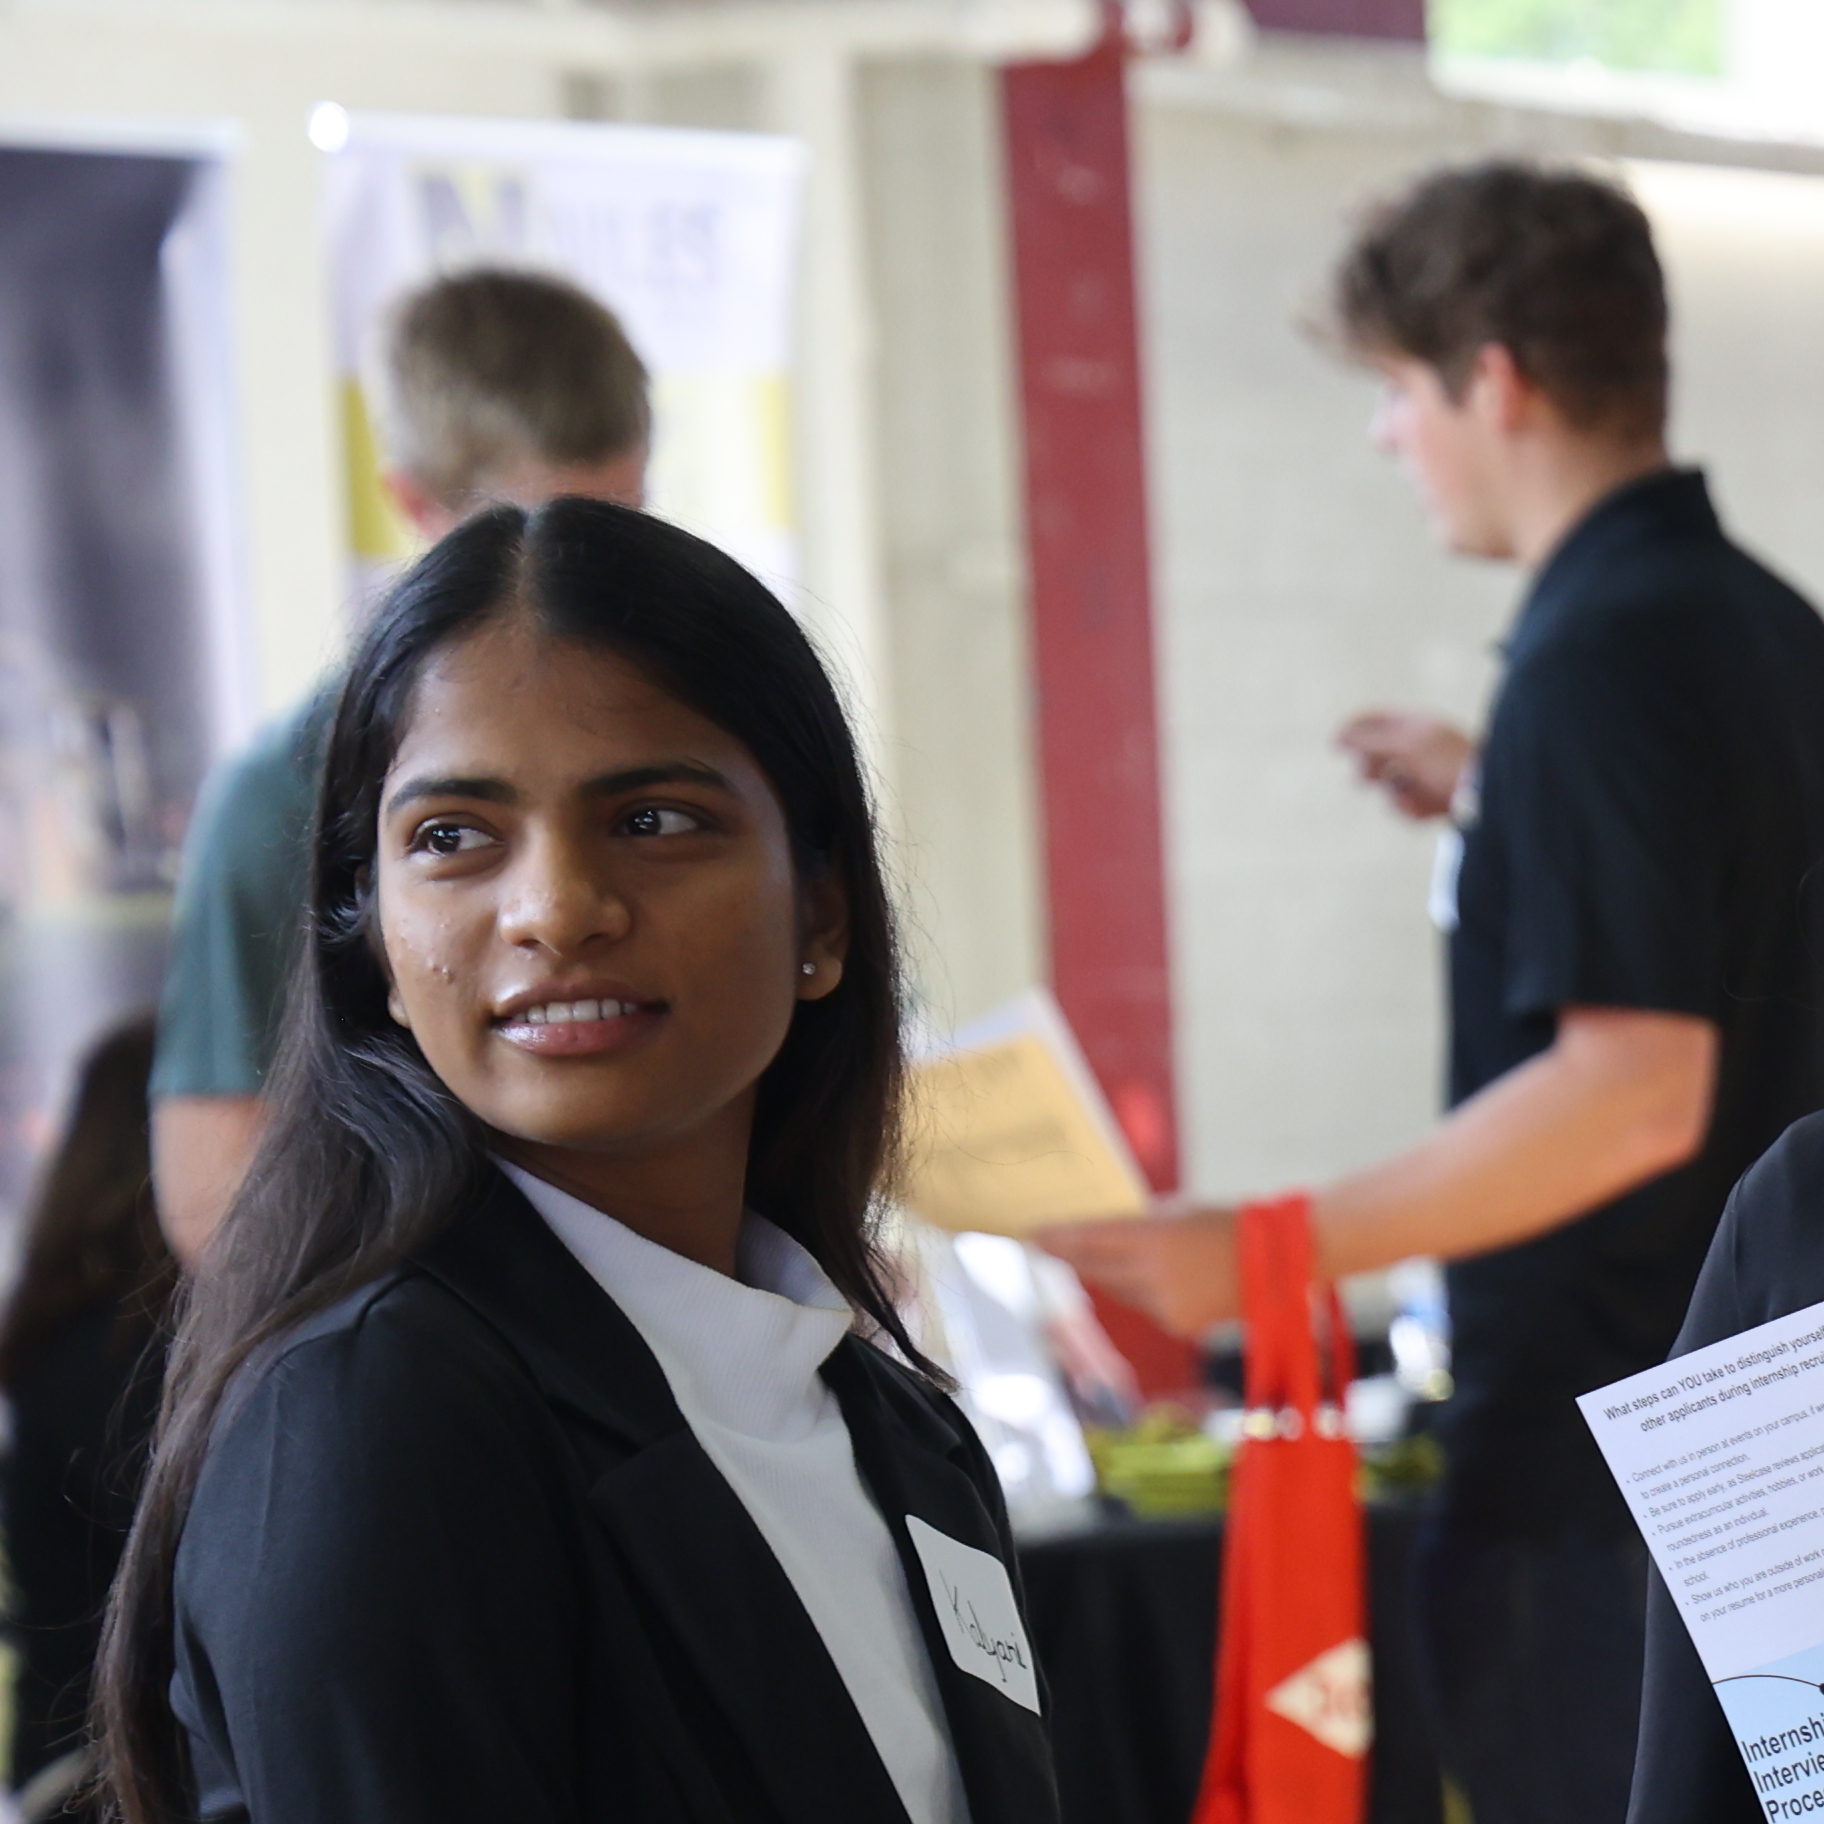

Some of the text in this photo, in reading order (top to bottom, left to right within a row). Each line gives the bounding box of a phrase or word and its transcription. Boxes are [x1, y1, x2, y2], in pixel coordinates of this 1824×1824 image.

[1603, 1402, 1633, 1420] What
[1631, 1393, 1660, 1410] steps
[1660, 1385, 1680, 1399] can
[1677, 1373, 1703, 1391] YOU
[1701, 1368, 1725, 1382] take
[1723, 1363, 1737, 1374] to
[1736, 1342, 1790, 1369] distinguish
[1640, 1414, 1666, 1431] other
[1667, 1395, 1718, 1422] applicants
[1718, 1383, 1753, 1401] during
[1749, 1364, 1800, 1389] internship
[1700, 1612, 1712, 1621] on
[1710, 1605, 1728, 1620] your
[1727, 1595, 1756, 1610] resume
[1754, 1591, 1766, 1600] for
[1766, 1589, 1774, 1597] a
[1772, 1582, 1794, 1594] more
